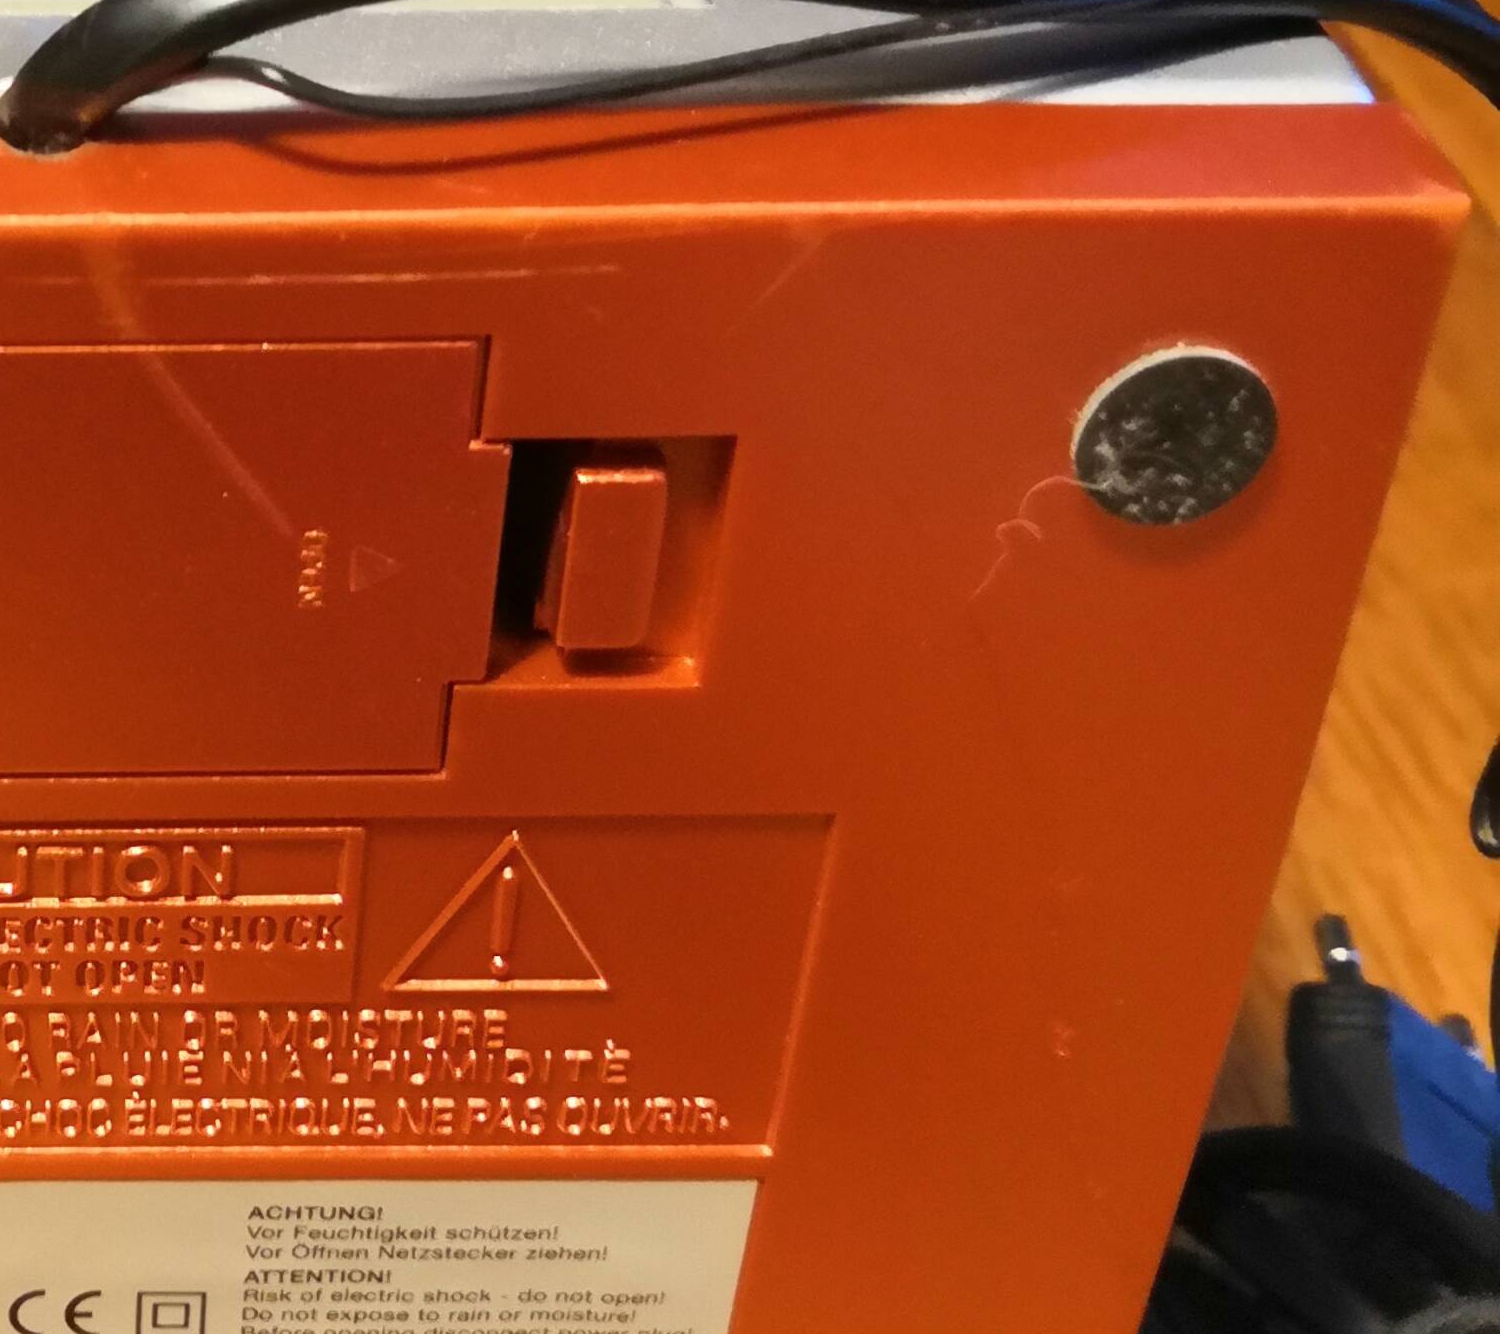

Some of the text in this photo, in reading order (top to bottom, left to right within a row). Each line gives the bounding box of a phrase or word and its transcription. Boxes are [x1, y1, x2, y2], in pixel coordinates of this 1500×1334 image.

[180, 916, 344, 952] SHOCK
[76, 959, 205, 996] OPEN
[48, 1011, 160, 1050] RAIN
[182, 1010, 239, 1051] OR
[258, 1009, 508, 1050] MOISTURE
[55, 1050, 205, 1086] PLUIE
[393, 1097, 455, 1135] NE
[461, 1096, 547, 1135] PAS
[248, 1205, 383, 1220] ACHTUNG!
[247, 1224, 559, 1243] Vor Feuchtigkeit schützen!
[245, 1242, 608, 1261] Vor Öffnen Netzstecker ziehen!
[243, 1269, 392, 1284] ATTENTION!
[243, 1288, 292, 1303] Risk
[300, 1288, 322, 1303] of
[330, 1287, 415, 1303] electric
[423, 1288, 491, 1303] shock
[517, 1288, 548, 1303] do
[555, 1289, 593, 1303] not
[600, 1290, 666, 1307] open!
[242, 1306, 636, 1325] Do not expose to rain or moisture!
